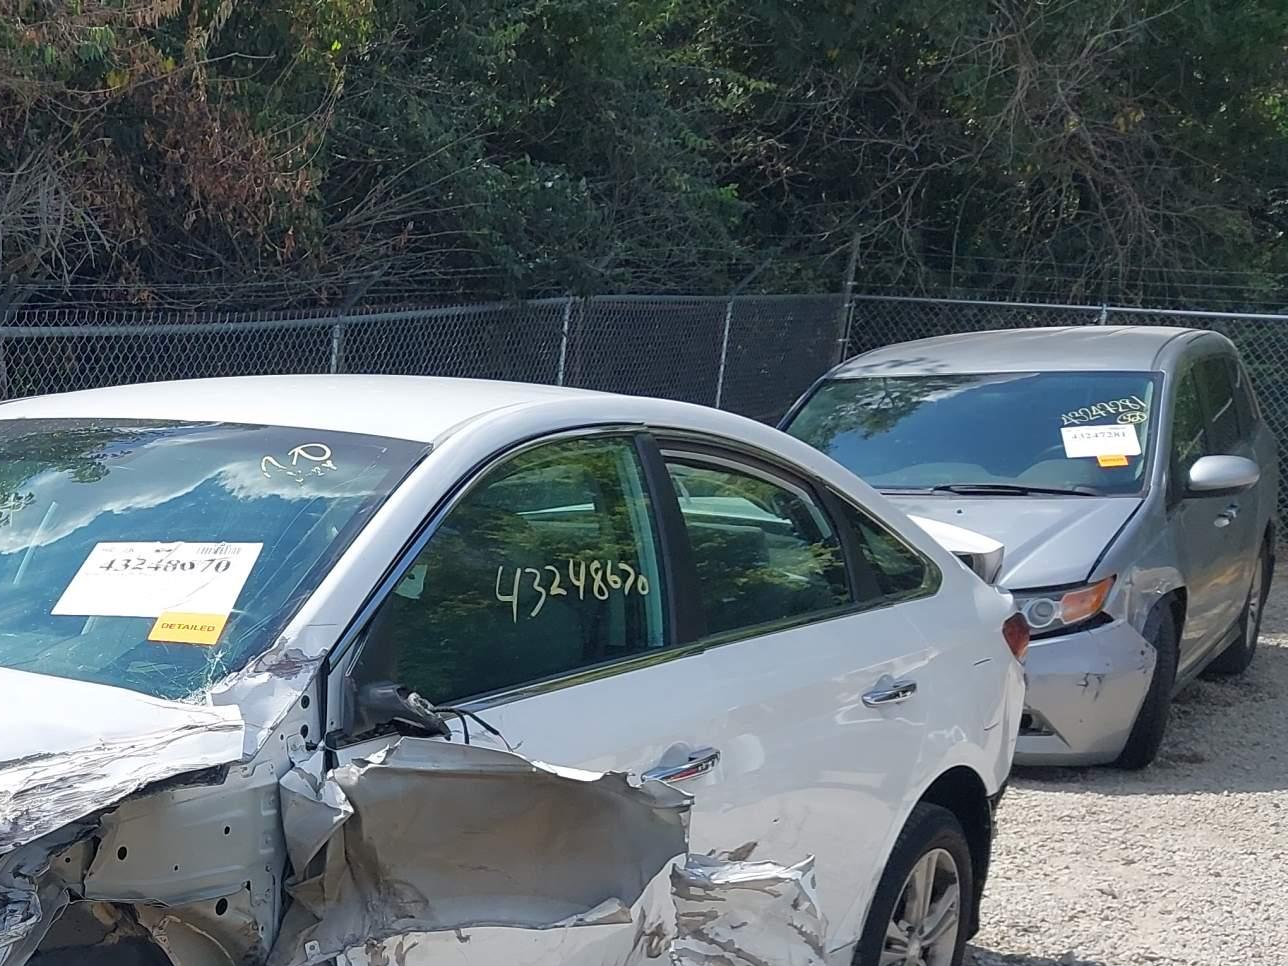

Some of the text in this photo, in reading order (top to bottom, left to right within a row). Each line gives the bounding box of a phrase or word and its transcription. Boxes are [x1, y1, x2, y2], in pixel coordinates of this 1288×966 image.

[1061, 395, 1146, 425] 43247281
[496, 559, 649, 623] 43248670
[161, 622, 215, 632] DETAILED
